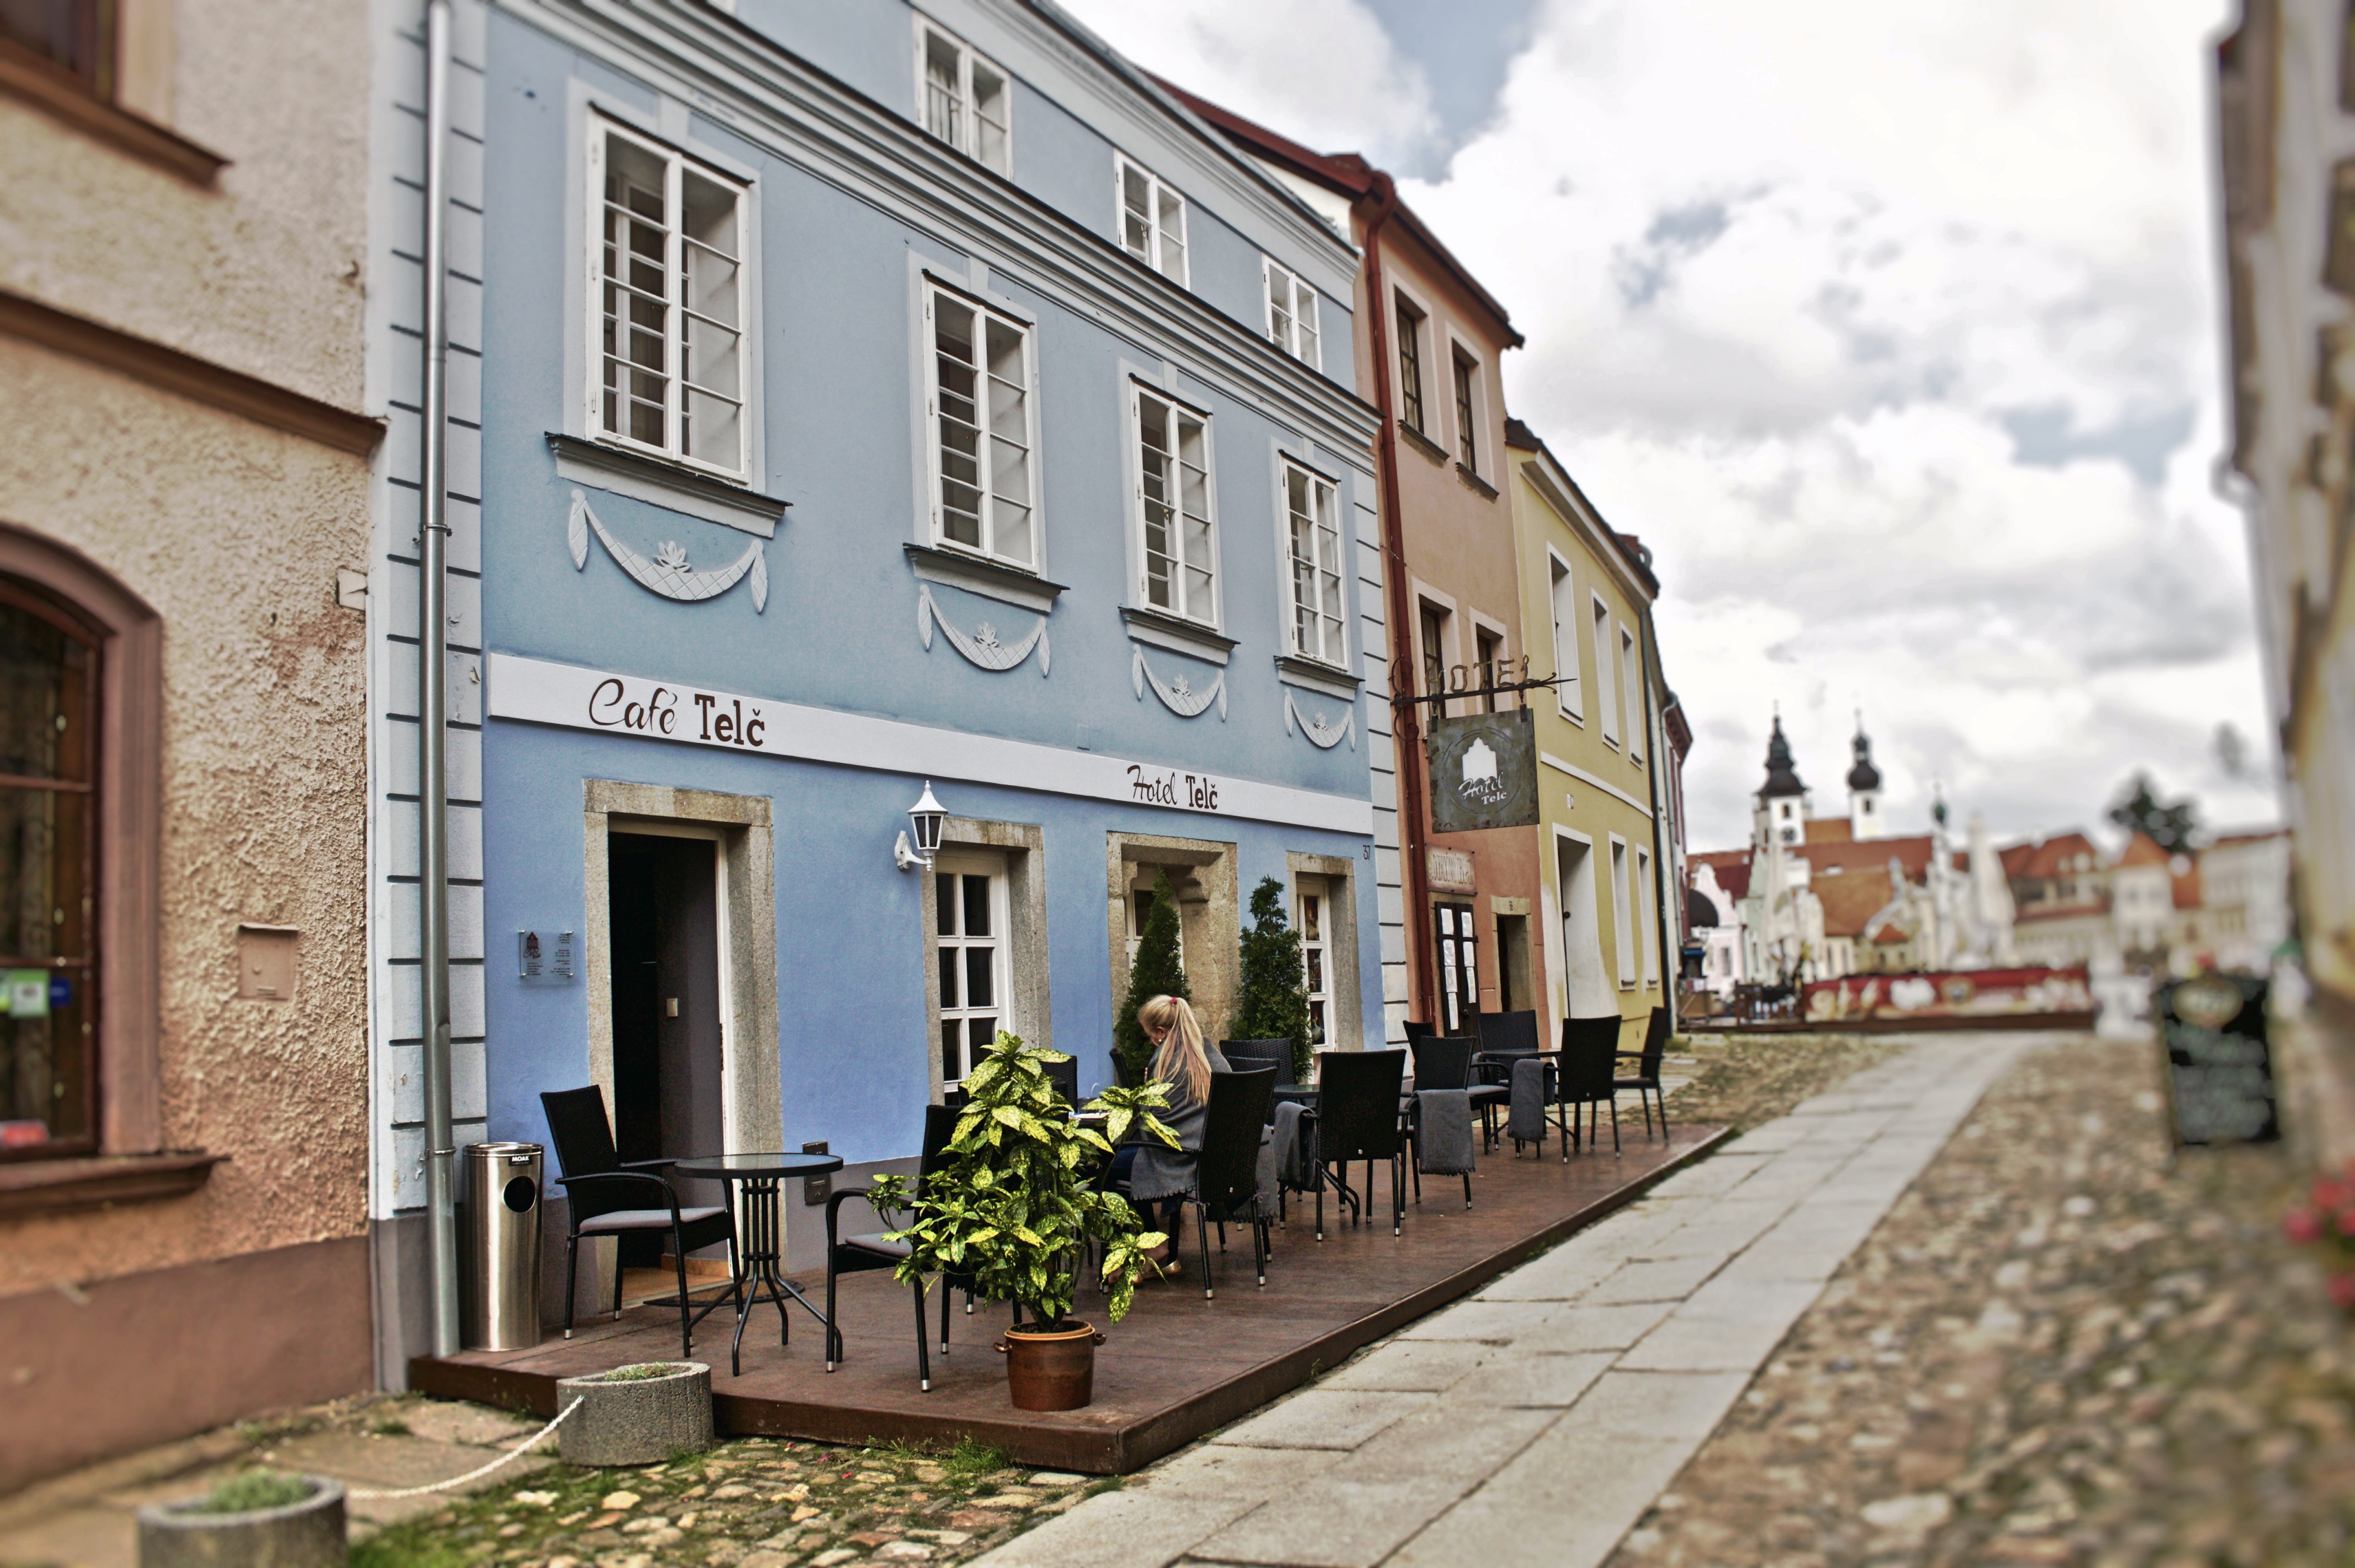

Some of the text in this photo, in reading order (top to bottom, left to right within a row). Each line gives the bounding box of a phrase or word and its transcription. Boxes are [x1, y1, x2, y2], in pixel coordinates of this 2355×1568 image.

[589, 678, 765, 747] Café Telč
[1127, 765, 1218, 810] Hotel Telč
[1458, 770, 1503, 800] Hotel
[1363, 845, 1370, 860] 37
